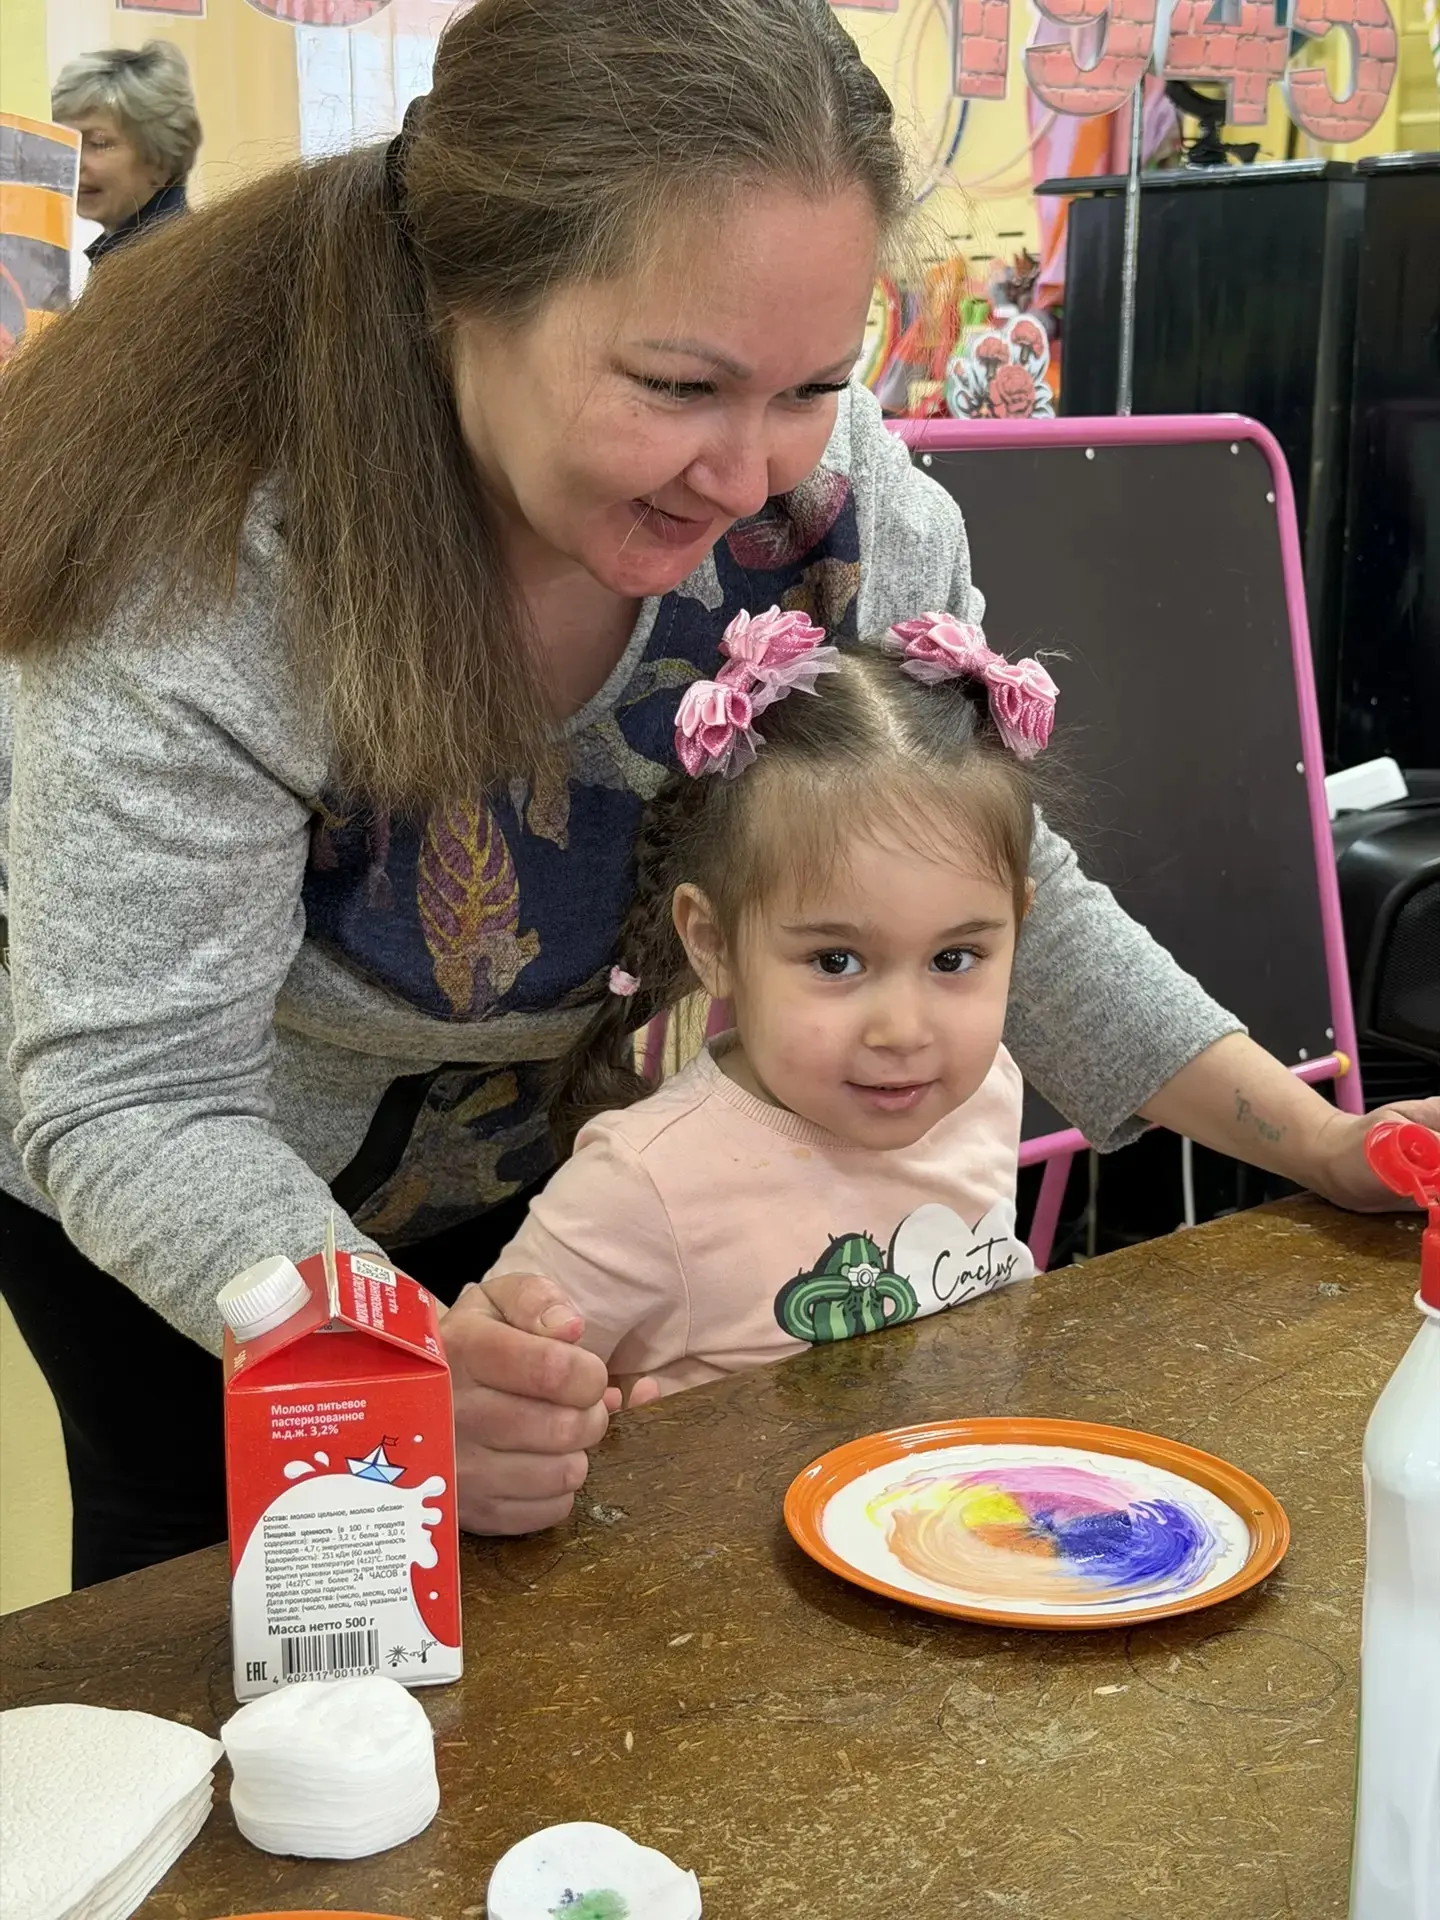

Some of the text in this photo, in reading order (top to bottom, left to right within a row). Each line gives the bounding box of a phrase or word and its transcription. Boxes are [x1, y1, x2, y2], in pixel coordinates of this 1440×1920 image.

[932, 1237, 1019, 1301] Cactus
[270, 1399, 367, 1416] Молоко питьевое
[271, 1411, 365, 1428] пастеризованное
[271, 1424, 339, 1440] м.д.ж. 3,2%
[290, 1512, 316, 1520] молоко
[349, 1507, 375, 1515] молоко
[300, 1528, 333, 1537] ценность
[349, 1523, 362, 1532] 100
[374, 1520, 405, 1530] продукта
[295, 1563, 310, 1571] при
[385, 1553, 407, 1562] После
[327, 1576, 349, 1585] более
[353, 1572, 364, 1581] 24
[369, 1568, 398, 1579] ЧАСОВ
[265, 1598, 284, 1607] Дата
[267, 1616, 375, 1636] Масса нетто 500 г
[272, 1665, 377, 1685] 4 602117 001169
